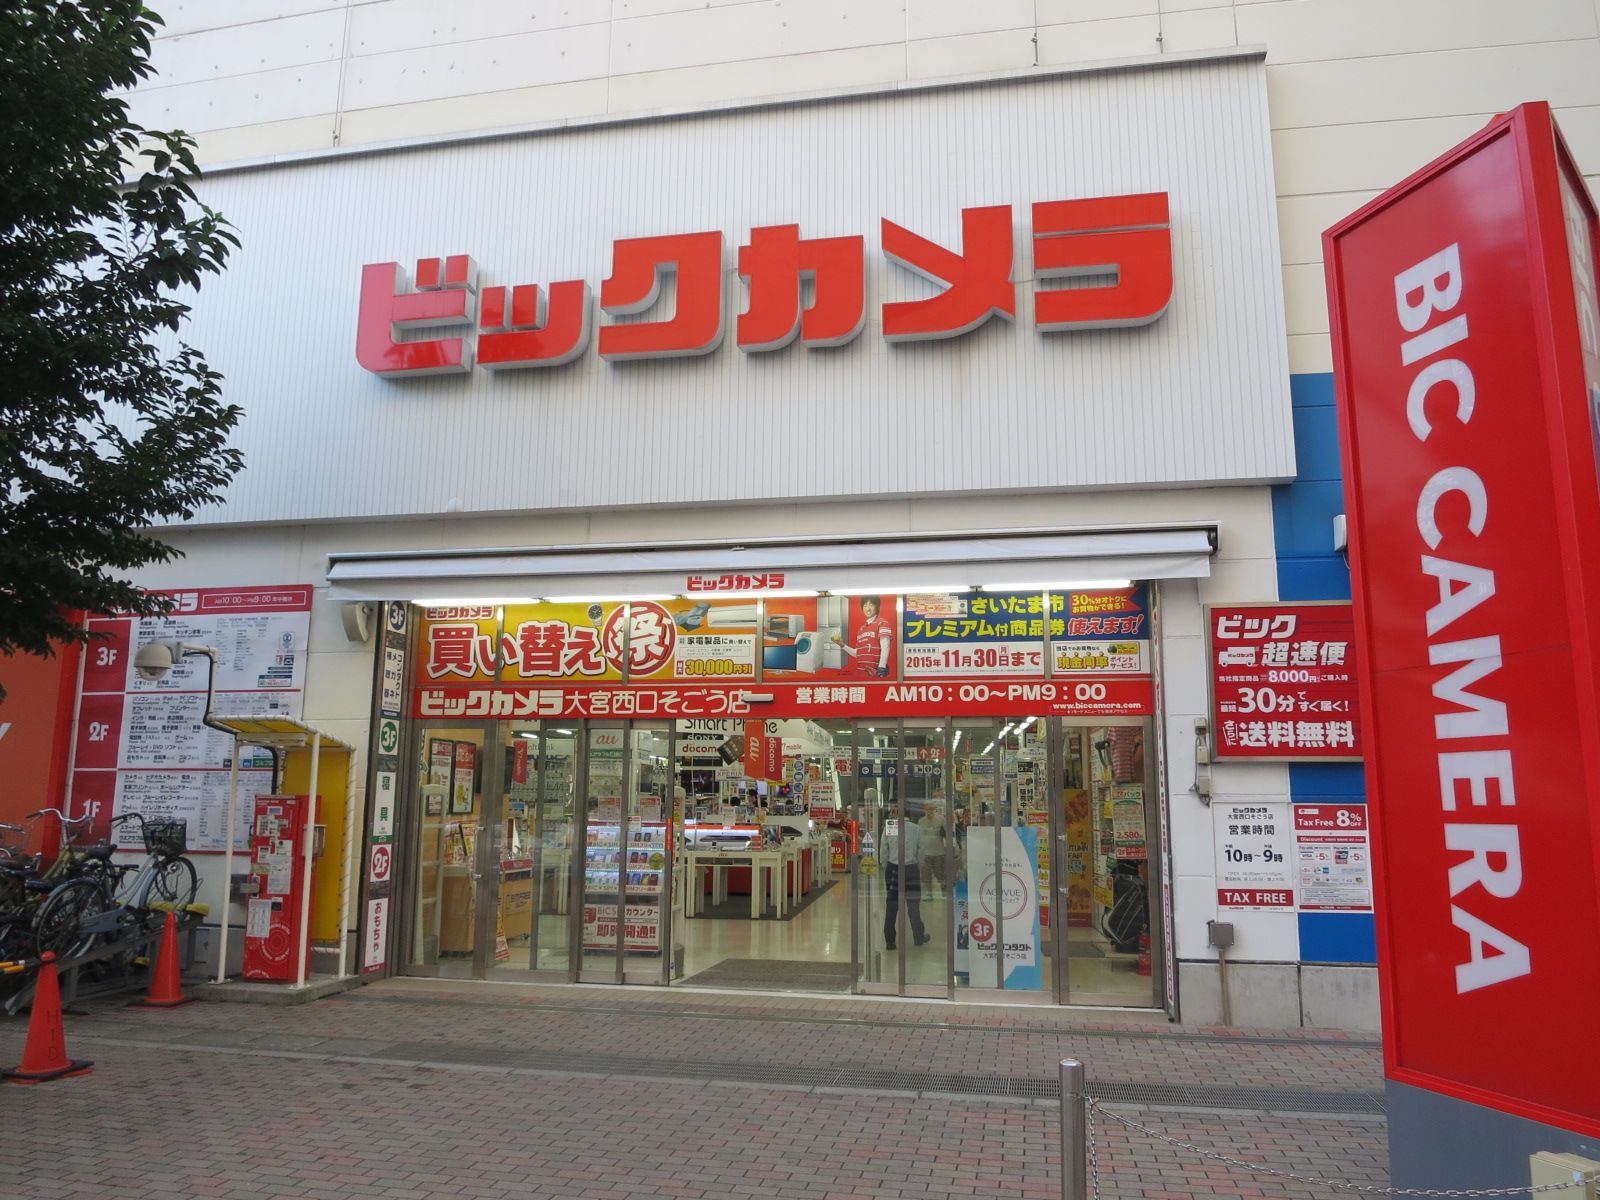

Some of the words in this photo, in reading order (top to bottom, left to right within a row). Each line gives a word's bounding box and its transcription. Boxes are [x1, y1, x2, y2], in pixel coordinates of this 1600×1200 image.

[356, 192, 1173, 375] ビックカメラ
[1394, 242, 1477, 443] BIC
[687, 573, 785, 591] ビックカメラ
[971, 594, 1065, 615] さいたま市
[391, 604, 405, 626] 3F
[1068, 614, 1144, 636] 使えます!
[906, 619, 1065, 638] プレミアム付商品券
[1217, 614, 1297, 639] ビック
[97, 646, 118, 666] 3F
[428, 622, 606, 677] 買い替え
[1261, 641, 1348, 667] 超速便
[685, 659, 753, 676] 30,000円引
[795, 686, 866, 705] 営業時間
[1052, 702, 1142, 710] www.biccamera.com
[88, 722, 109, 742] 2F
[684, 718, 727, 731] Smart
[1239, 720, 1355, 748] 送料無料
[1416, 465, 1532, 994] CAMERA
[382, 726, 396, 747] 3F
[596, 734, 618, 745] au
[682, 743, 720, 752] docom
[749, 736, 761, 762] au
[768, 737, 777, 773] docomo
[83, 799, 102, 818] 1F
[1228, 824, 1275, 836] 営業時間
[1298, 818, 1315, 827] Tax
[1315, 818, 1334, 827] Free
[373, 853, 388, 873] 2F
[1224, 848, 1283, 862] 10時～9時
[986, 889, 1021, 897] ACVUE
[1224, 892, 1250, 903] TAX
[1256, 892, 1287, 904] FREE
[973, 923, 990, 936] 3F
